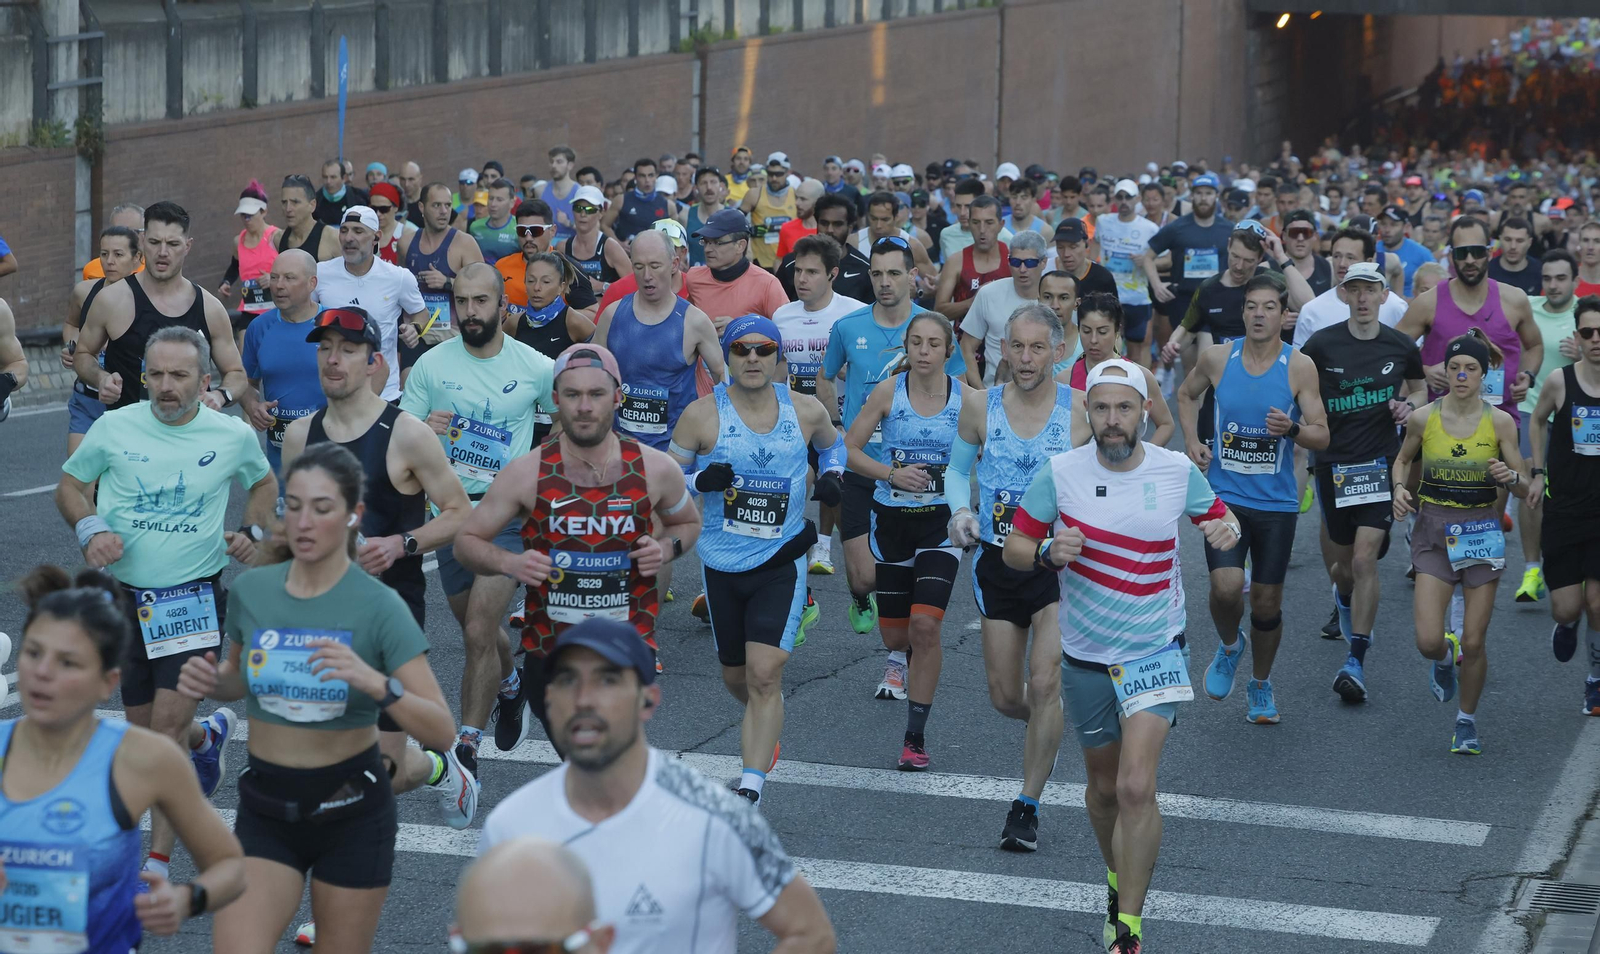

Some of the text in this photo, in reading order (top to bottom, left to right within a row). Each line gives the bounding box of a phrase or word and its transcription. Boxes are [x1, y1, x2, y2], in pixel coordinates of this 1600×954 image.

[633, 387, 663, 397] ZURICH
[632, 401, 649, 410] 3284
[1327, 385, 1394, 413] FINISHER
[281, 408, 310, 417] ZURICH
[622, 408, 661, 423] GERARD
[470, 440, 490, 453] 4792
[1240, 440, 1258, 449] 3139
[451, 446, 501, 471] CORREIA
[909, 452, 942, 462] ZURICH
[1222, 447, 1276, 462] FRANCISCO
[1353, 474, 1370, 483] 3674
[1430, 467, 1487, 483] CARCASSONNE
[748, 479, 784, 490] ZURICH
[1344, 481, 1380, 496] GERRIT
[747, 497, 768, 507] 4028
[737, 507, 776, 524] PABLO
[131, 519, 198, 534] SEVILLA'24
[549, 515, 636, 536] KENYA
[1465, 521, 1496, 532] ZURICH
[1468, 538, 1485, 547] 5101
[1464, 547, 1492, 559] CYCY
[576, 555, 622, 567] ZURICH
[576, 578, 603, 589] 3529
[548, 591, 630, 608] WHOLESOME
[165, 606, 188, 619] 4828
[149, 616, 210, 641] LAURENT
[1138, 660, 1162, 674] 4499
[1123, 670, 1181, 697] CALAFAT
[250, 683, 347, 702] CLAUTORREGO
[0, 845, 74, 867] ZURICH
